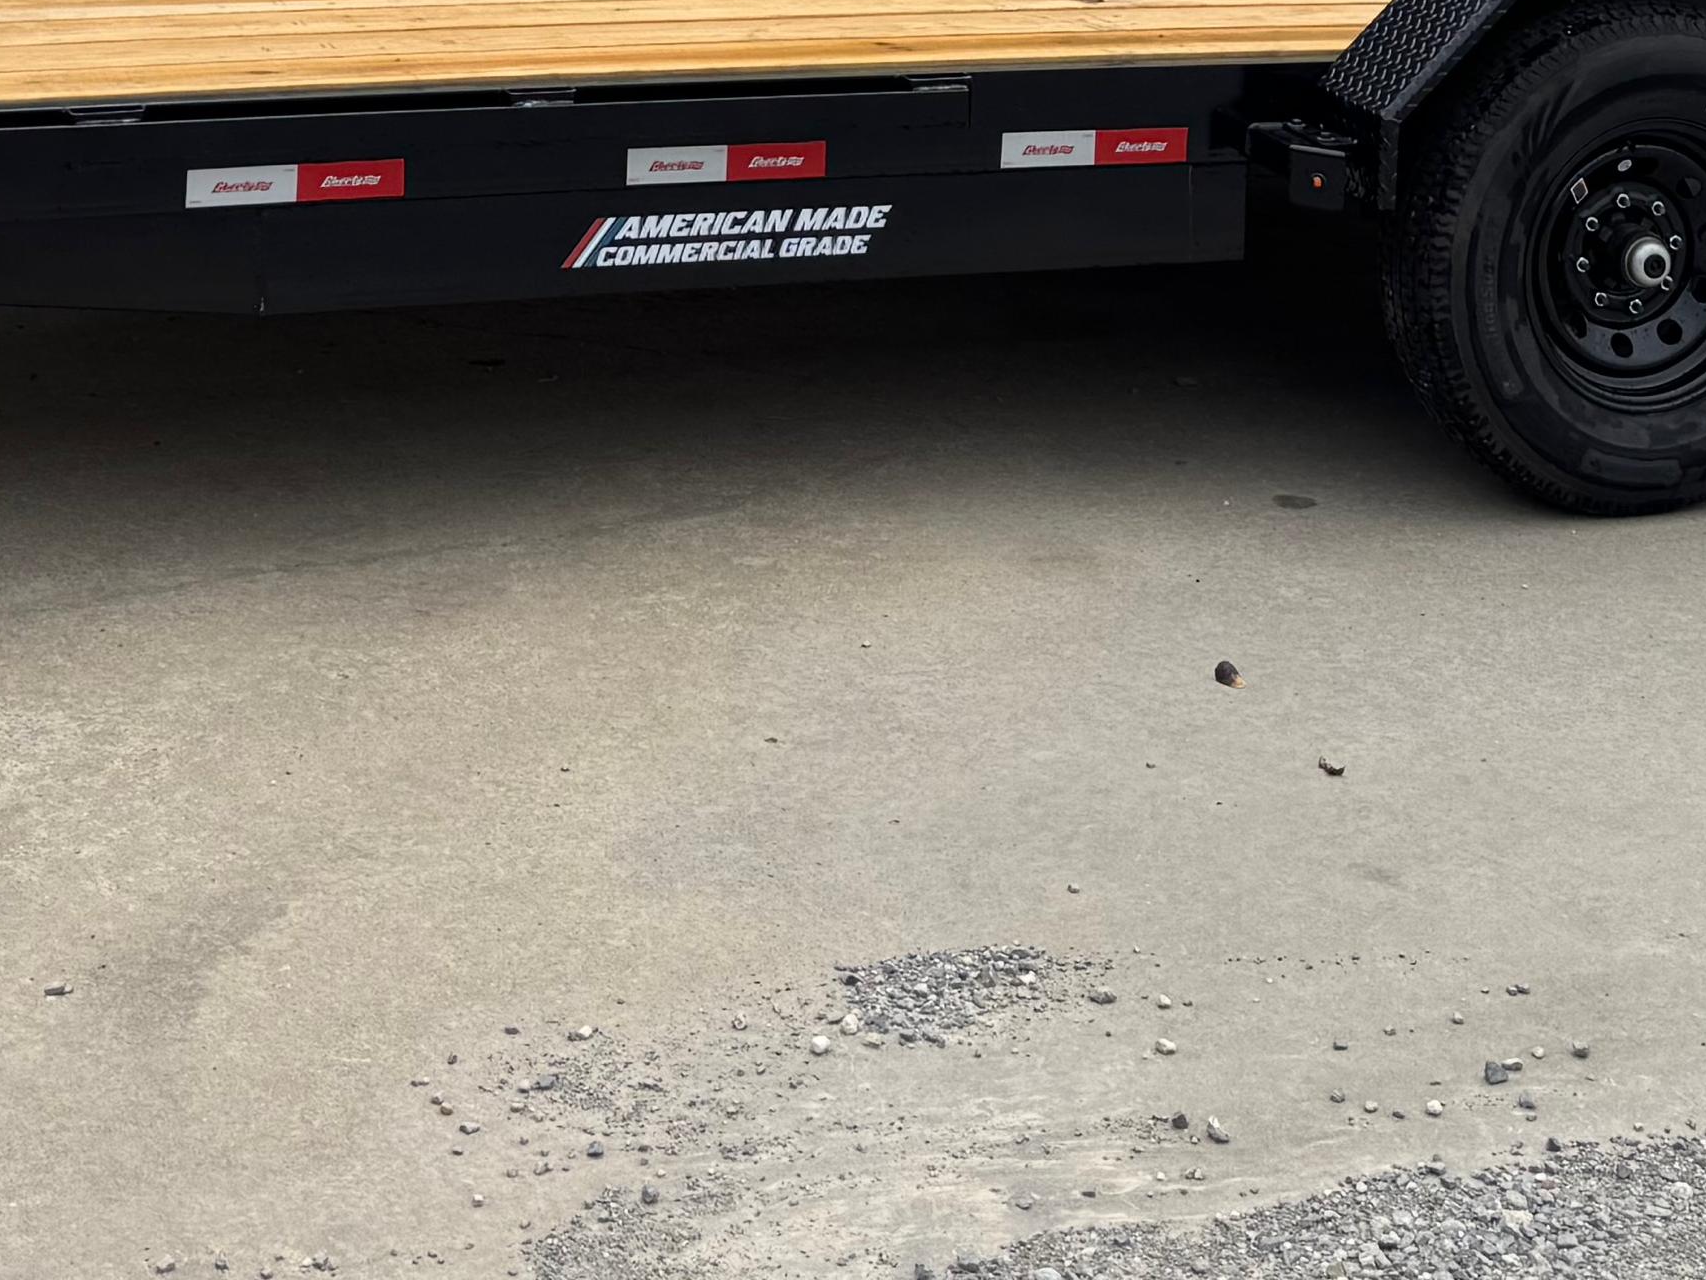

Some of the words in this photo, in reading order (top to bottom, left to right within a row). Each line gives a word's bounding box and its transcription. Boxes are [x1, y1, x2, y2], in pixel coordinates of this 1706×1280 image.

[614, 208, 794, 240] AMERICAN
[792, 205, 893, 232] MADE
[596, 238, 775, 267] COMMERCIAL
[779, 234, 872, 258] GRADE
